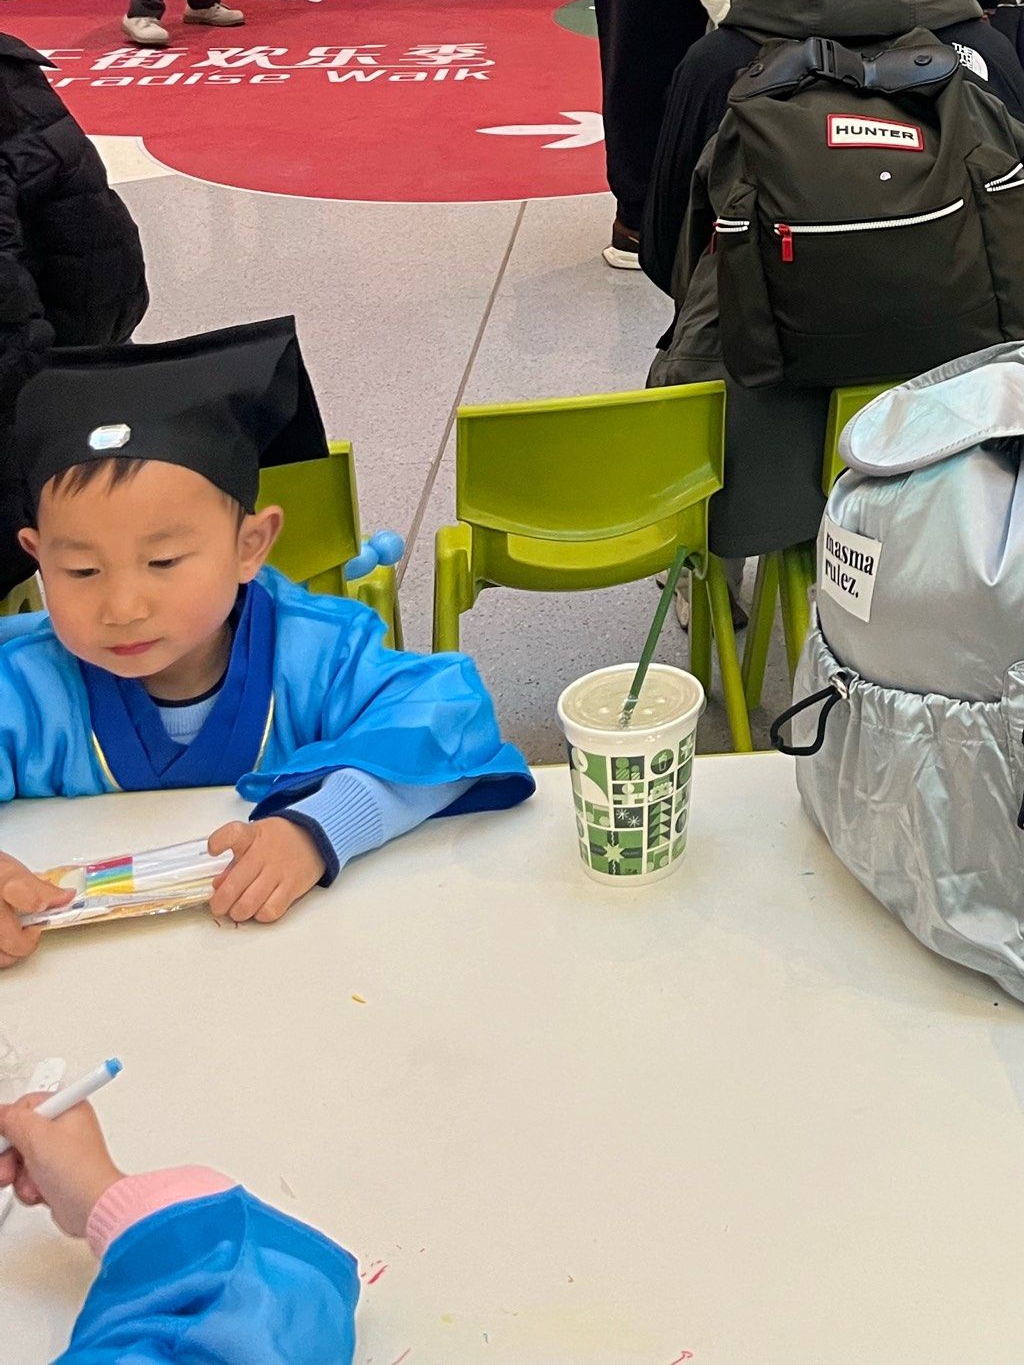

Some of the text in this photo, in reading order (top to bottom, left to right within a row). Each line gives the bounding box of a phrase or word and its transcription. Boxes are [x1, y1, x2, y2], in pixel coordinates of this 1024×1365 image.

[326, 68, 491, 83] Walk
[835, 125, 915, 141] HUNTER
[825, 532, 875, 576] masma
[825, 557, 860, 599] rulez.
